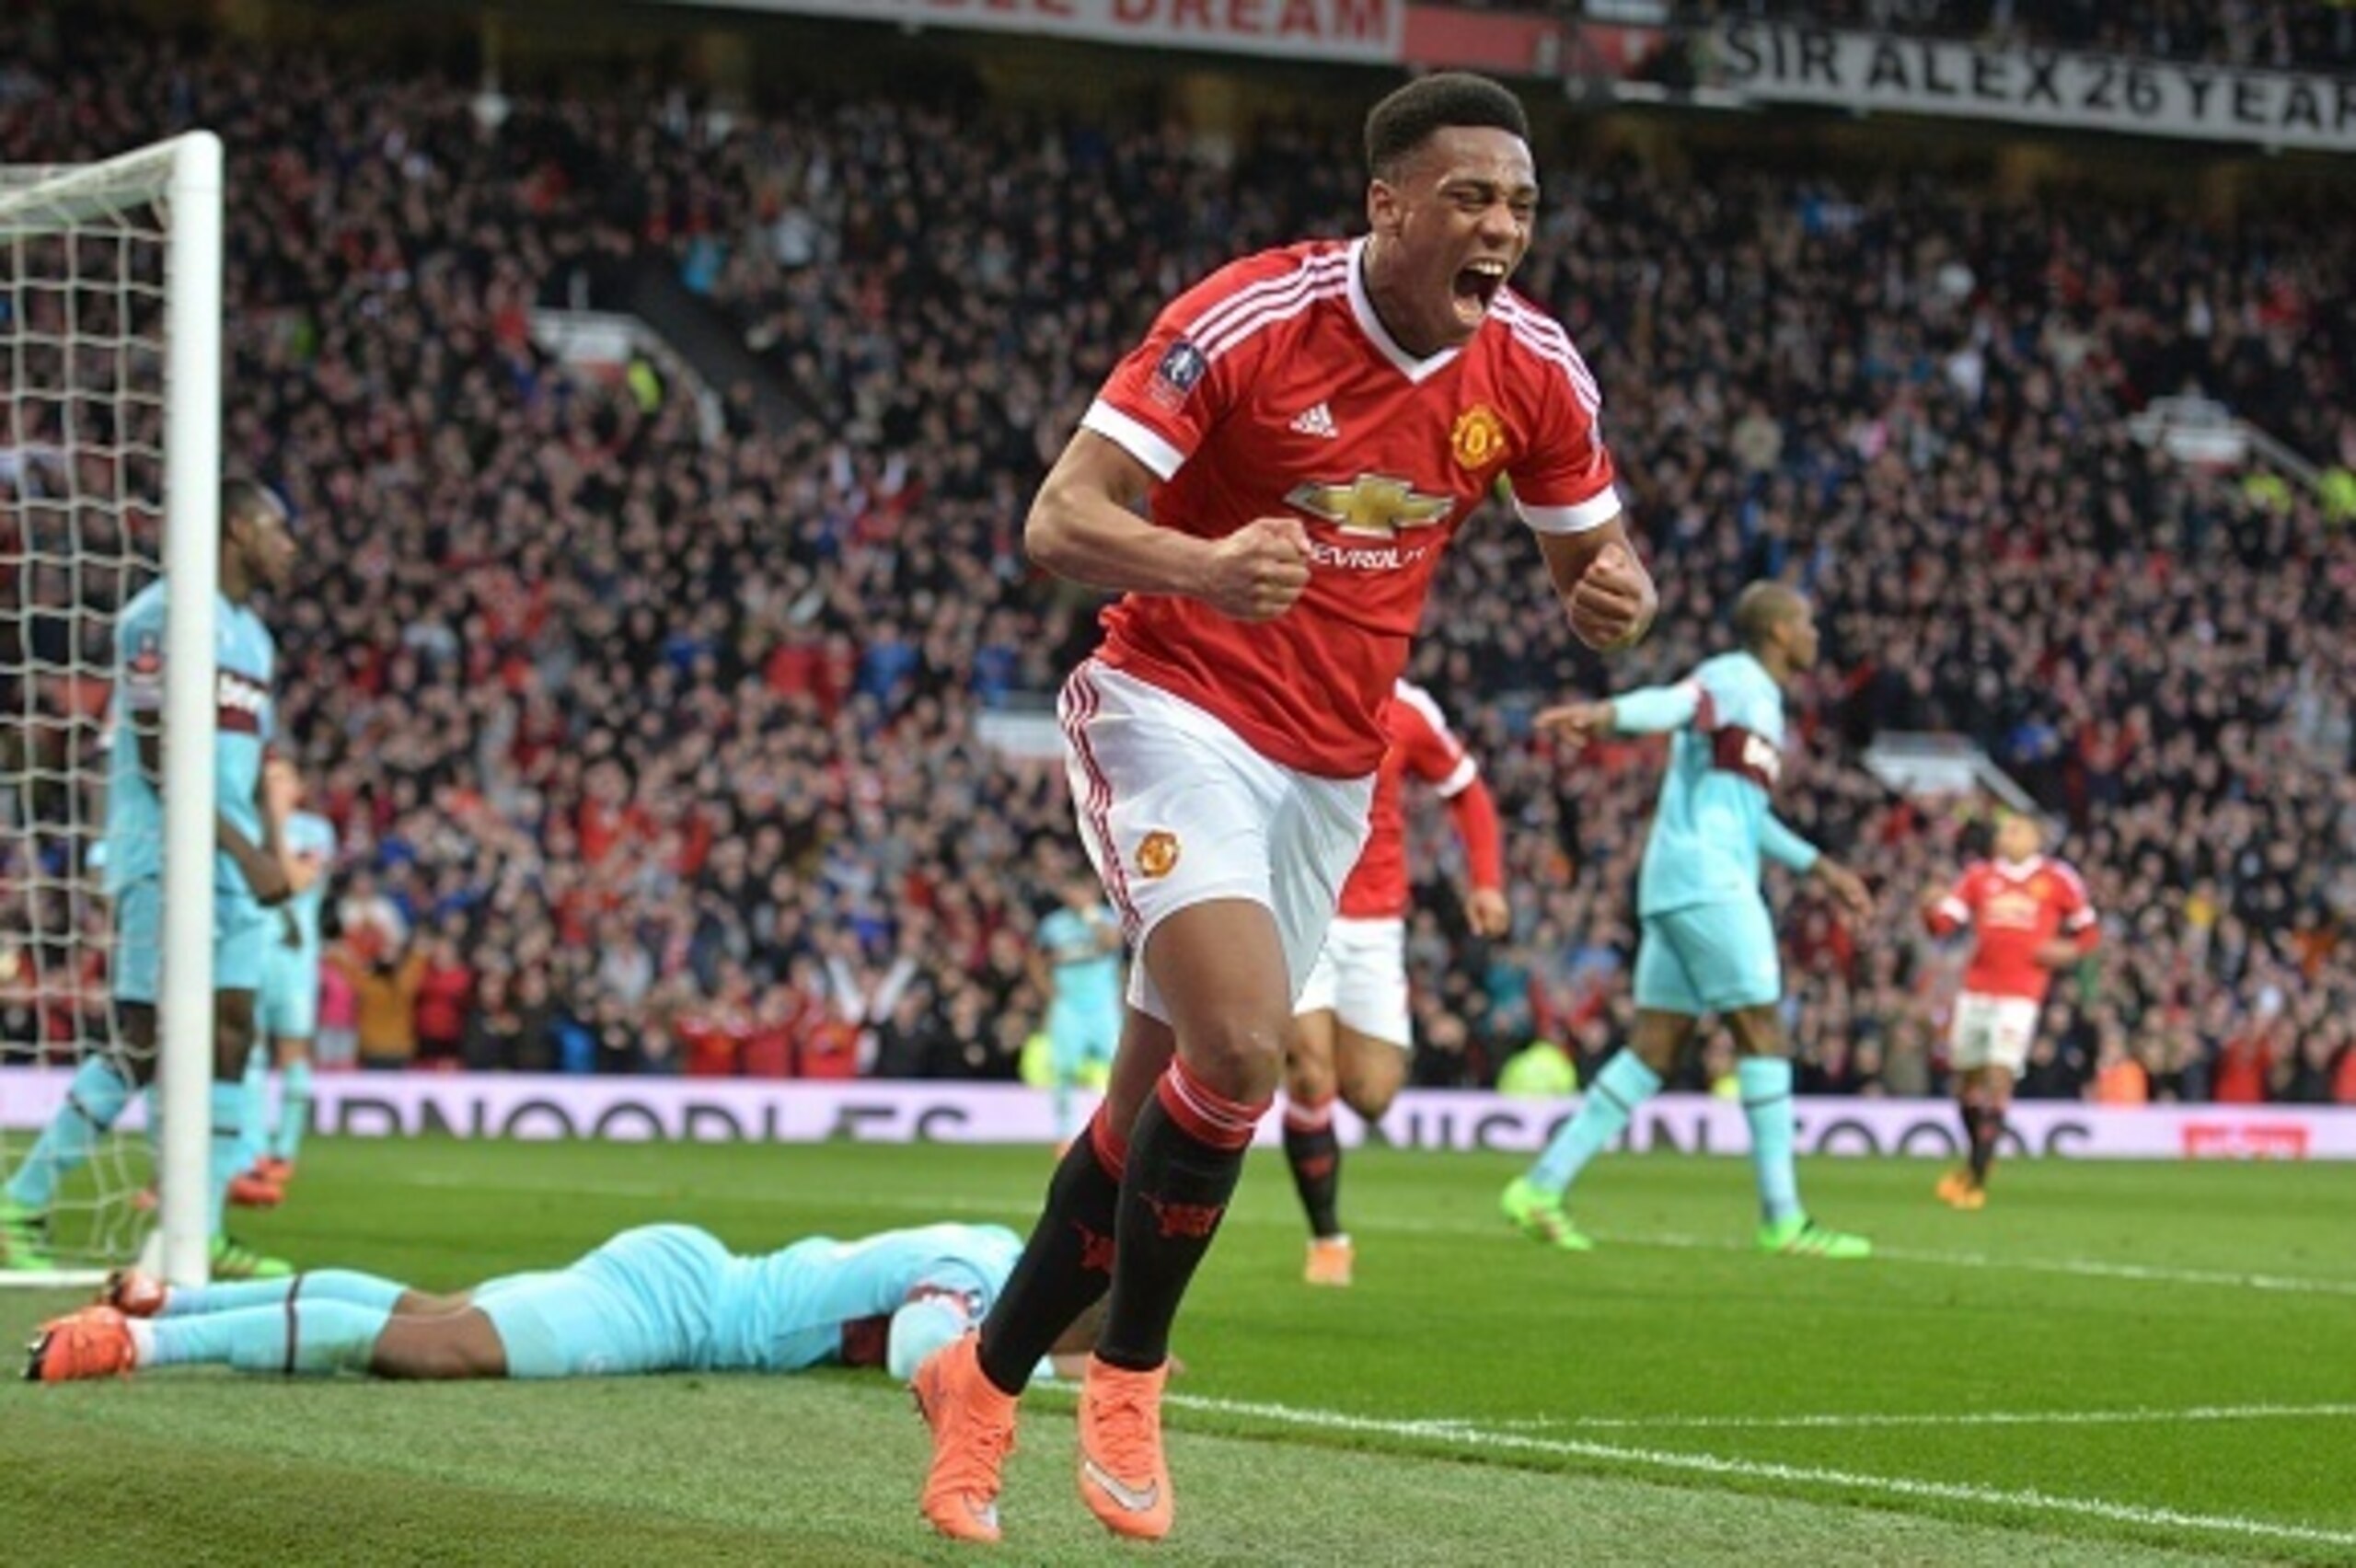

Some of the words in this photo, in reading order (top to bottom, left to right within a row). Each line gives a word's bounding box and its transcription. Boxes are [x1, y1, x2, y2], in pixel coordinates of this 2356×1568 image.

[1719, 24, 1840, 86] SIR
[1868, 35, 2062, 106] ALEX
[2081, 57, 2163, 119] 26
